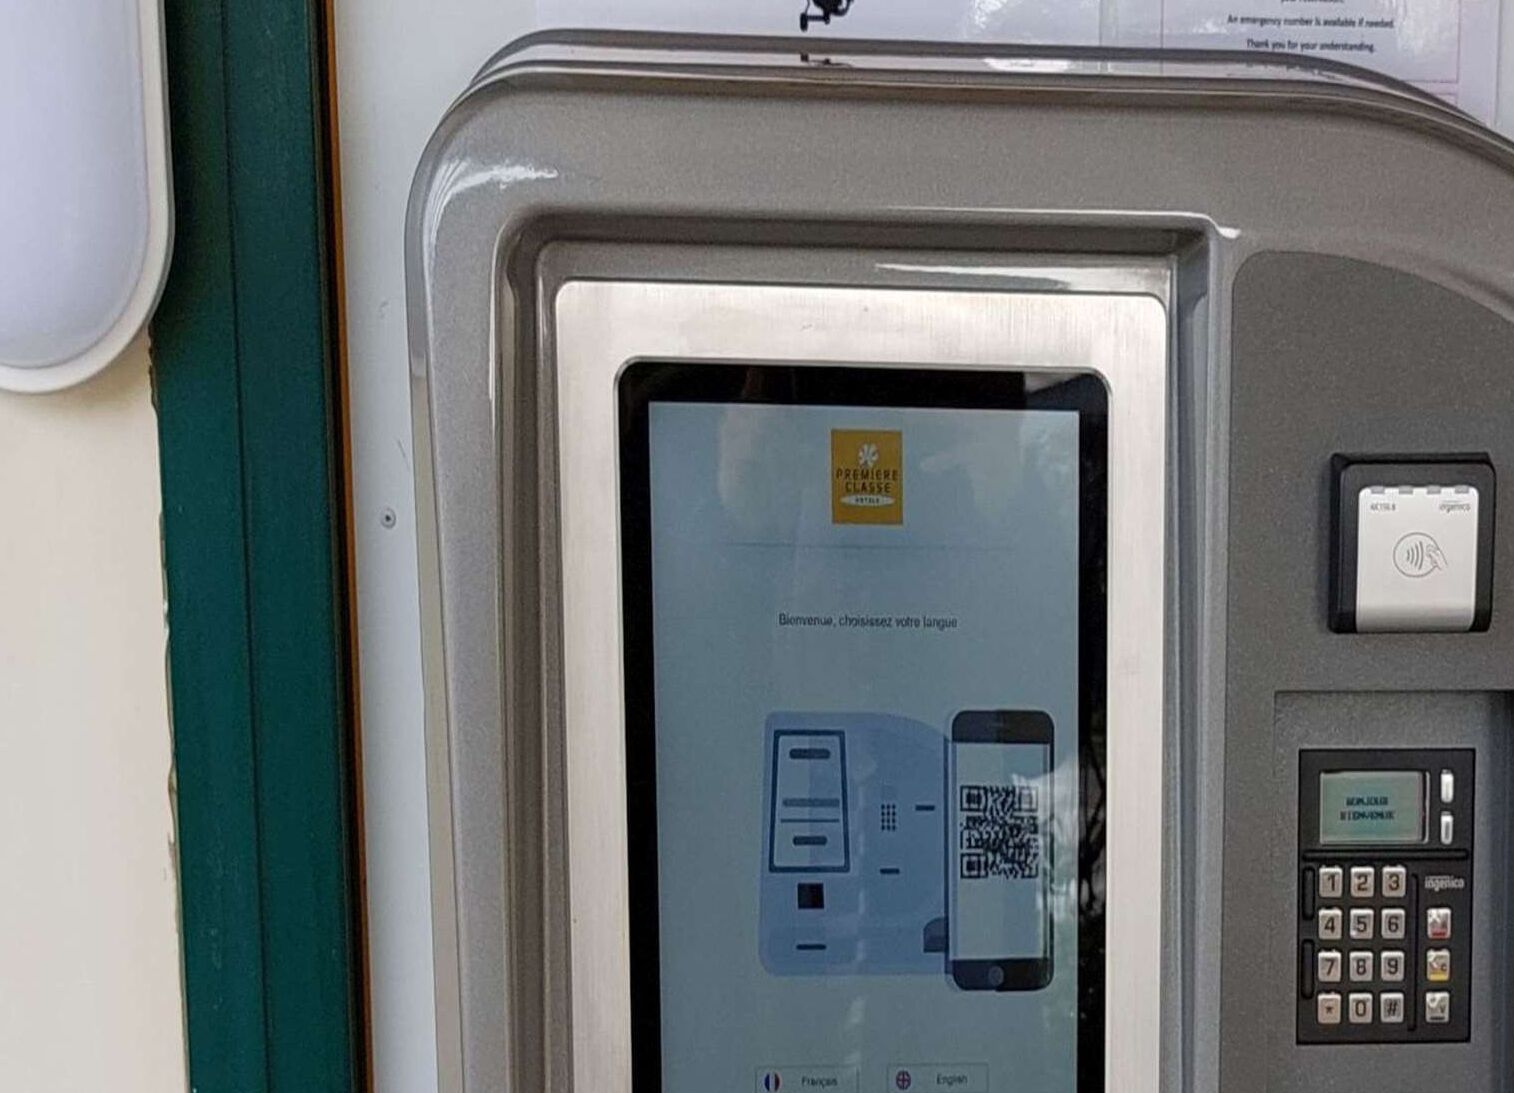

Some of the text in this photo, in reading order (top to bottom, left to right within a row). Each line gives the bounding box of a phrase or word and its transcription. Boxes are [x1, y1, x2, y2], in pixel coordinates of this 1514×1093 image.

[844, 480, 894, 494] CLASSE
[779, 613, 837, 628] Bienvenue,
[895, 617, 921, 628] votre
[923, 615, 957, 631] langue
[1327, 874, 1465, 892] 1 2 3 ingenico
[1324, 916, 1399, 932] 4 5 6
[1325, 959, 1335, 976] 7
[1356, 958, 1367, 975] 8
[1387, 958, 1398, 974] 9
[1355, 1002, 1367, 1016] 0
[802, 1074, 968, 1089] Français English
